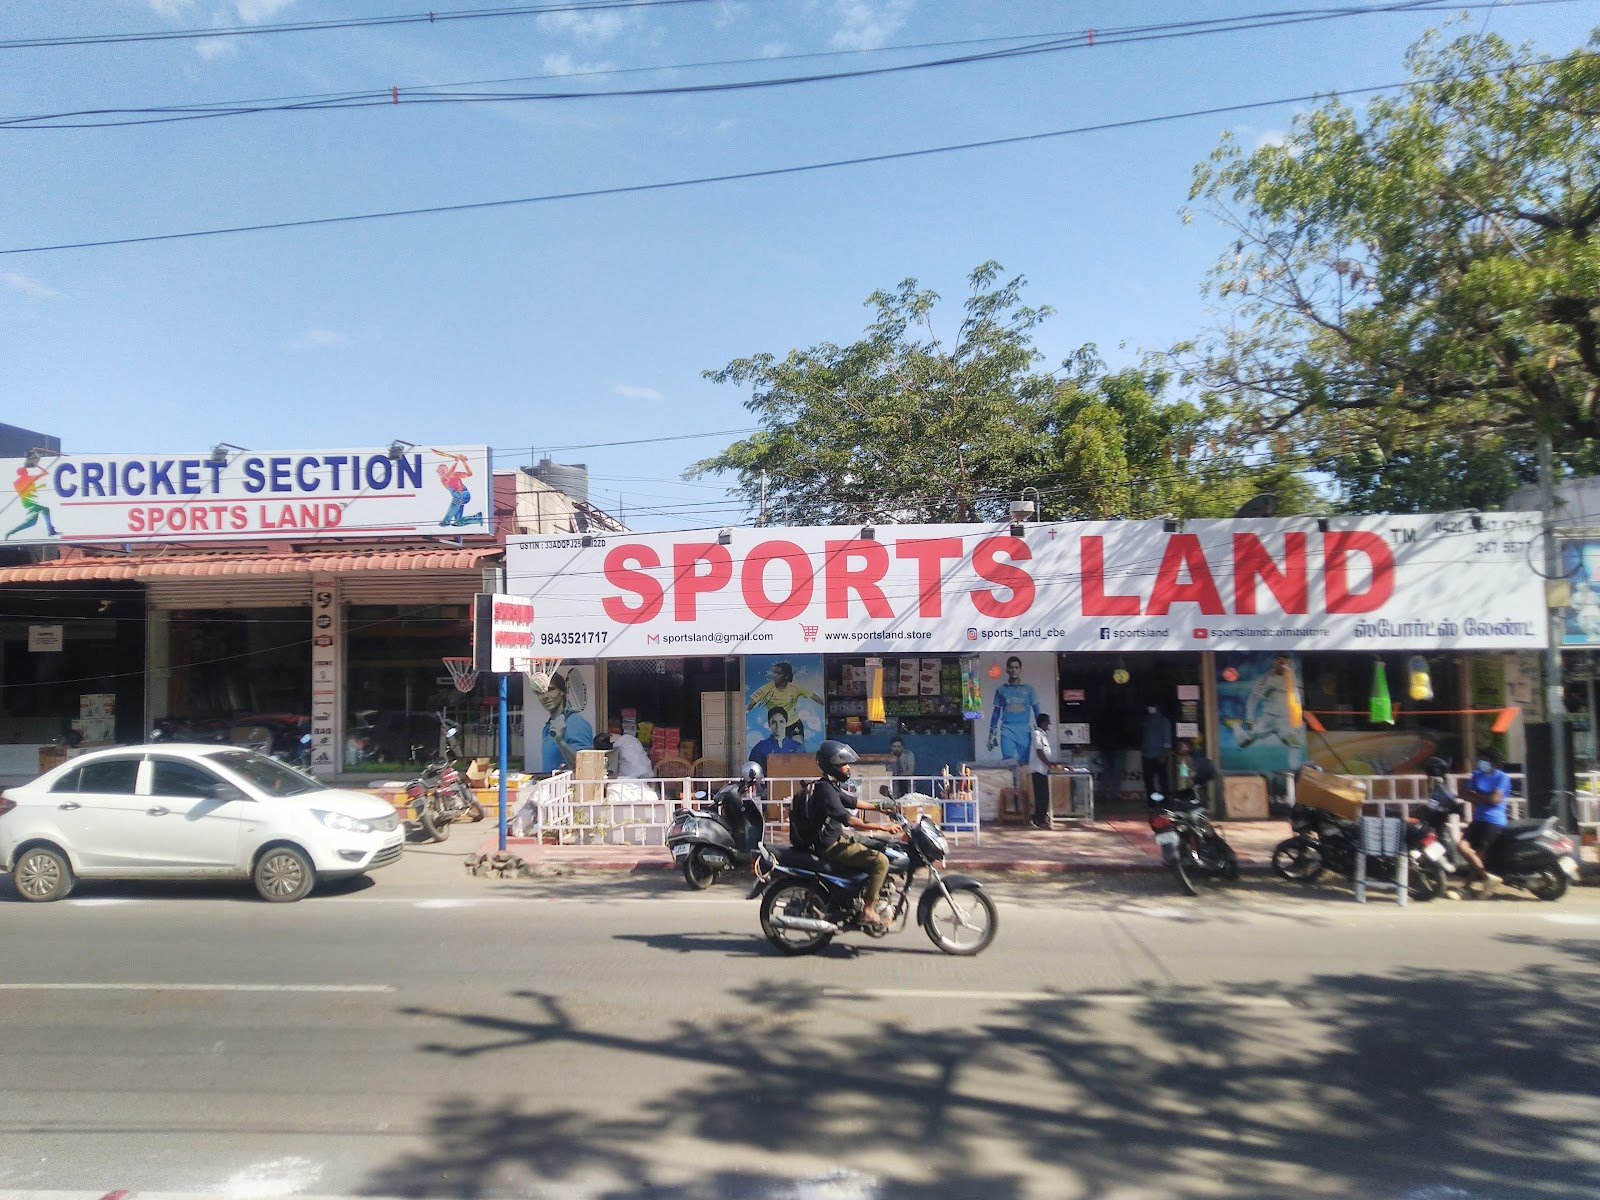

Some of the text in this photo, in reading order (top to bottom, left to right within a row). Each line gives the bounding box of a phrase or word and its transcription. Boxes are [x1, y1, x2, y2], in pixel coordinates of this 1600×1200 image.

[54, 453, 422, 498] CRICKET SECTION
[128, 505, 249, 532] SPORTS
[260, 503, 342, 529] LAND
[520, 542, 540, 550] GSTIN
[602, 529, 1417, 624] SPORTS LAND TM
[540, 631, 608, 646] 9843521717
[662, 632, 774, 645] sportsland@gmail.com
[824, 629, 932, 641] www.sportsland.store
[980, 628, 1066, 640] sports_land_cbe
[1113, 628, 1170, 640] sportsland
